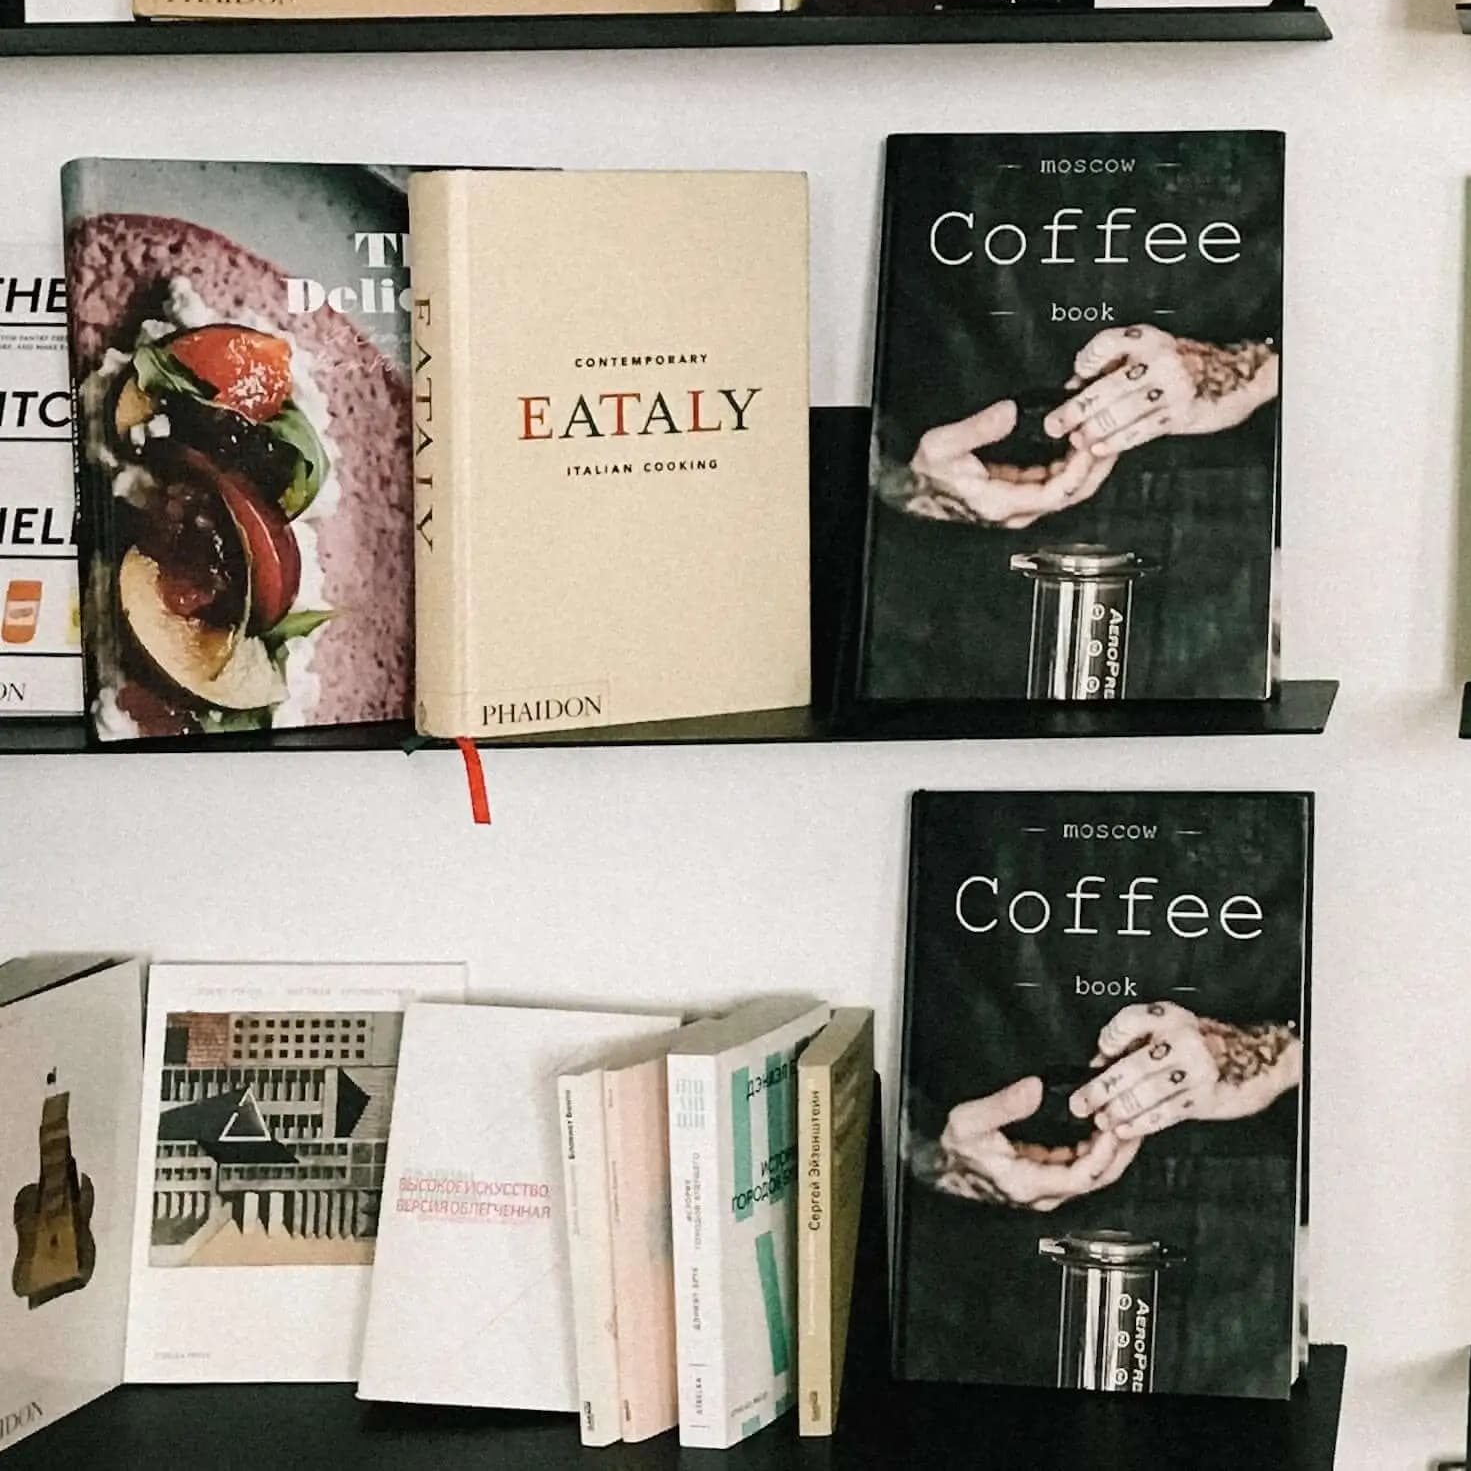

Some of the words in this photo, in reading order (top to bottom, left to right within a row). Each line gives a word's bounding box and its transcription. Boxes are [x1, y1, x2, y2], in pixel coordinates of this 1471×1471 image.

[1039, 155, 1137, 175] moscow
[929, 208, 1243, 267] Coffee
[1050, 302, 1116, 323] book
[574, 352, 710, 369] CONTEMPORARY
[517, 387, 763, 442] EATALY
[566, 463, 633, 477] ITALIAN
[643, 459, 719, 473] COOKING
[481, 695, 603, 727] PHAIDON
[1062, 820, 1158, 841] moscow
[954, 875, 1264, 940] Coffee
[1074, 975, 1139, 997] book
[807, 1090, 821, 1179] Эйзенштейн
[807, 1180, 823, 1232] Сергей
